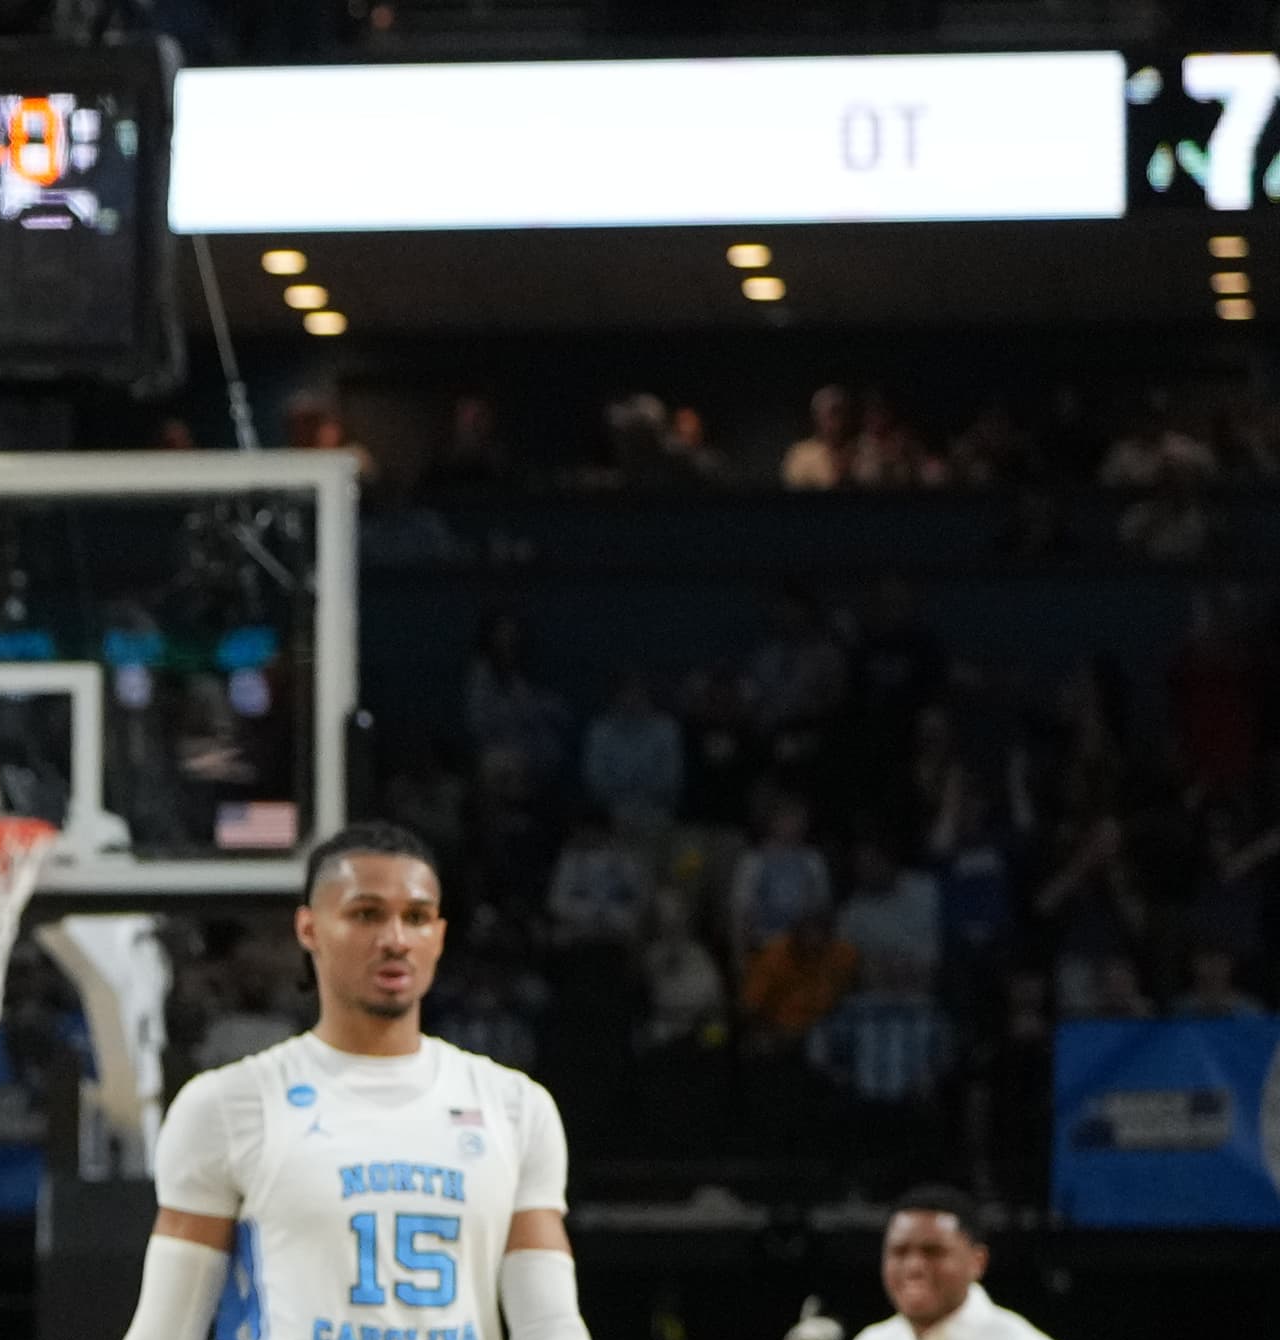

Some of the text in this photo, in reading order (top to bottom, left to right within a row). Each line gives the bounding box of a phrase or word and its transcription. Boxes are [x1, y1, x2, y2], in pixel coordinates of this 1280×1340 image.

[841, 99, 928, 172] OT
[338, 1161, 466, 1203] NORTH
[349, 1211, 461, 1308] 15
